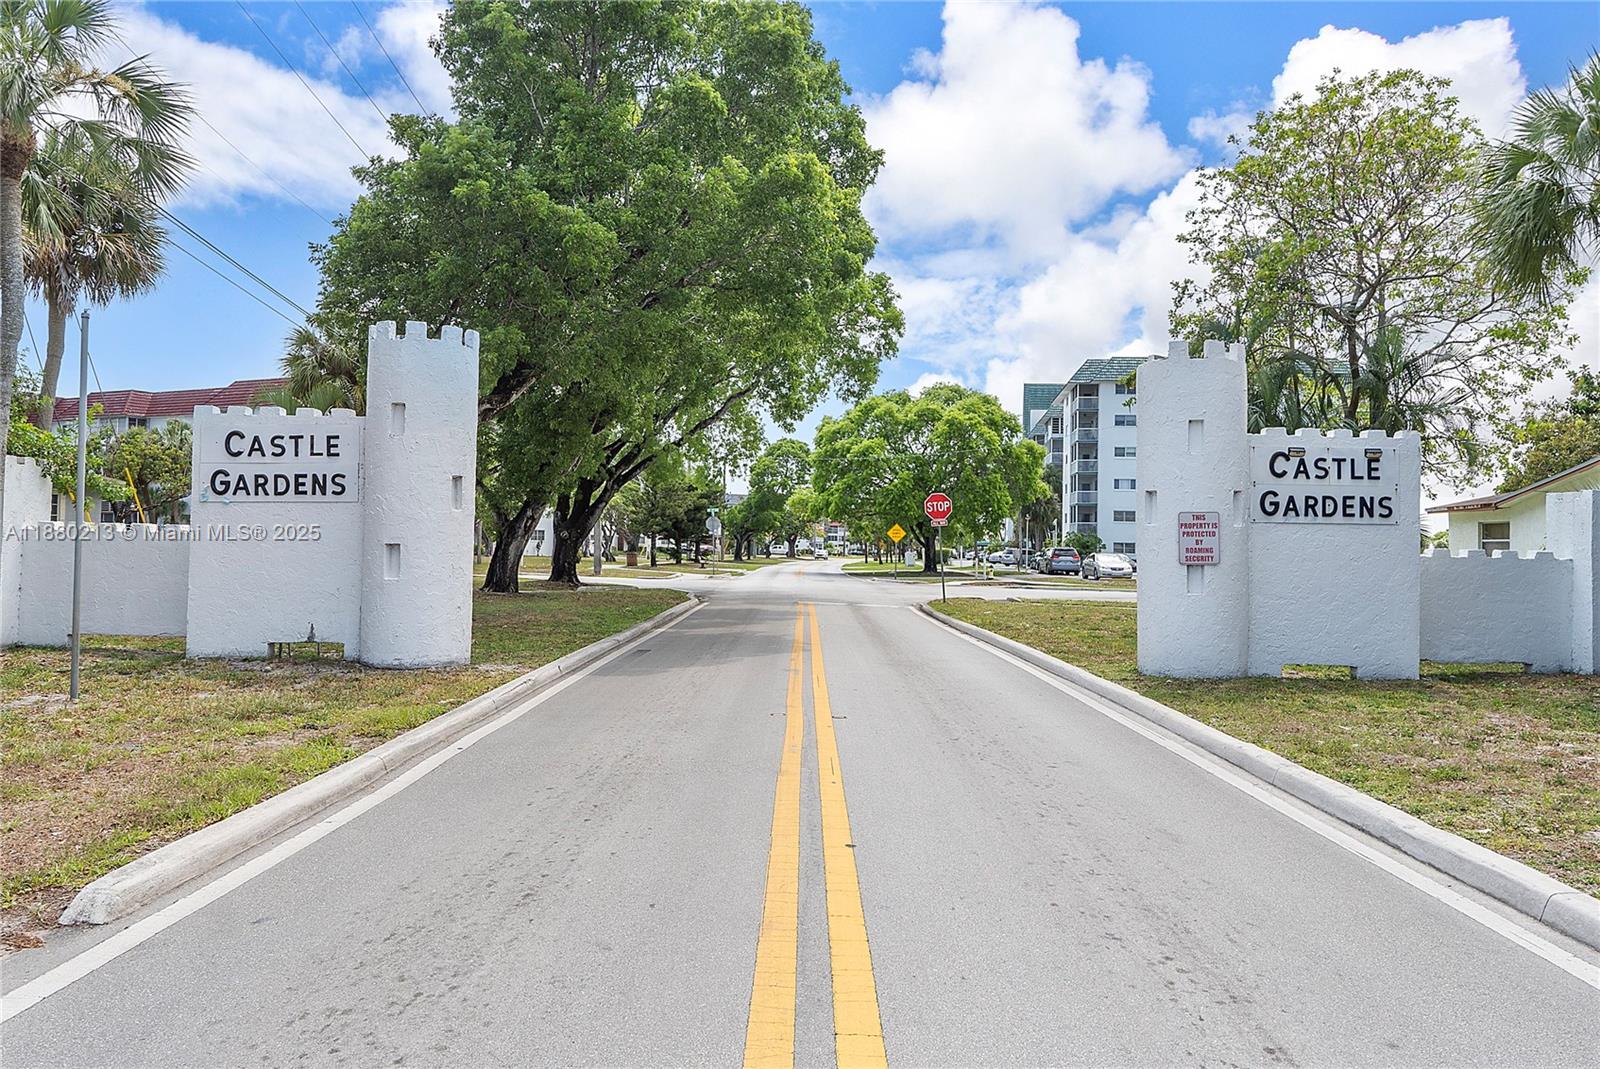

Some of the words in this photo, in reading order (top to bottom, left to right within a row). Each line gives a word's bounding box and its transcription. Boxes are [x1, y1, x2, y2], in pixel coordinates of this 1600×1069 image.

[224, 430, 340, 457] CASTLE
[1269, 451, 1381, 480] CASTLE
[210, 469, 346, 496] GARDENS
[927, 501, 950, 512] STOP
[1259, 490, 1393, 518] GARDENS
